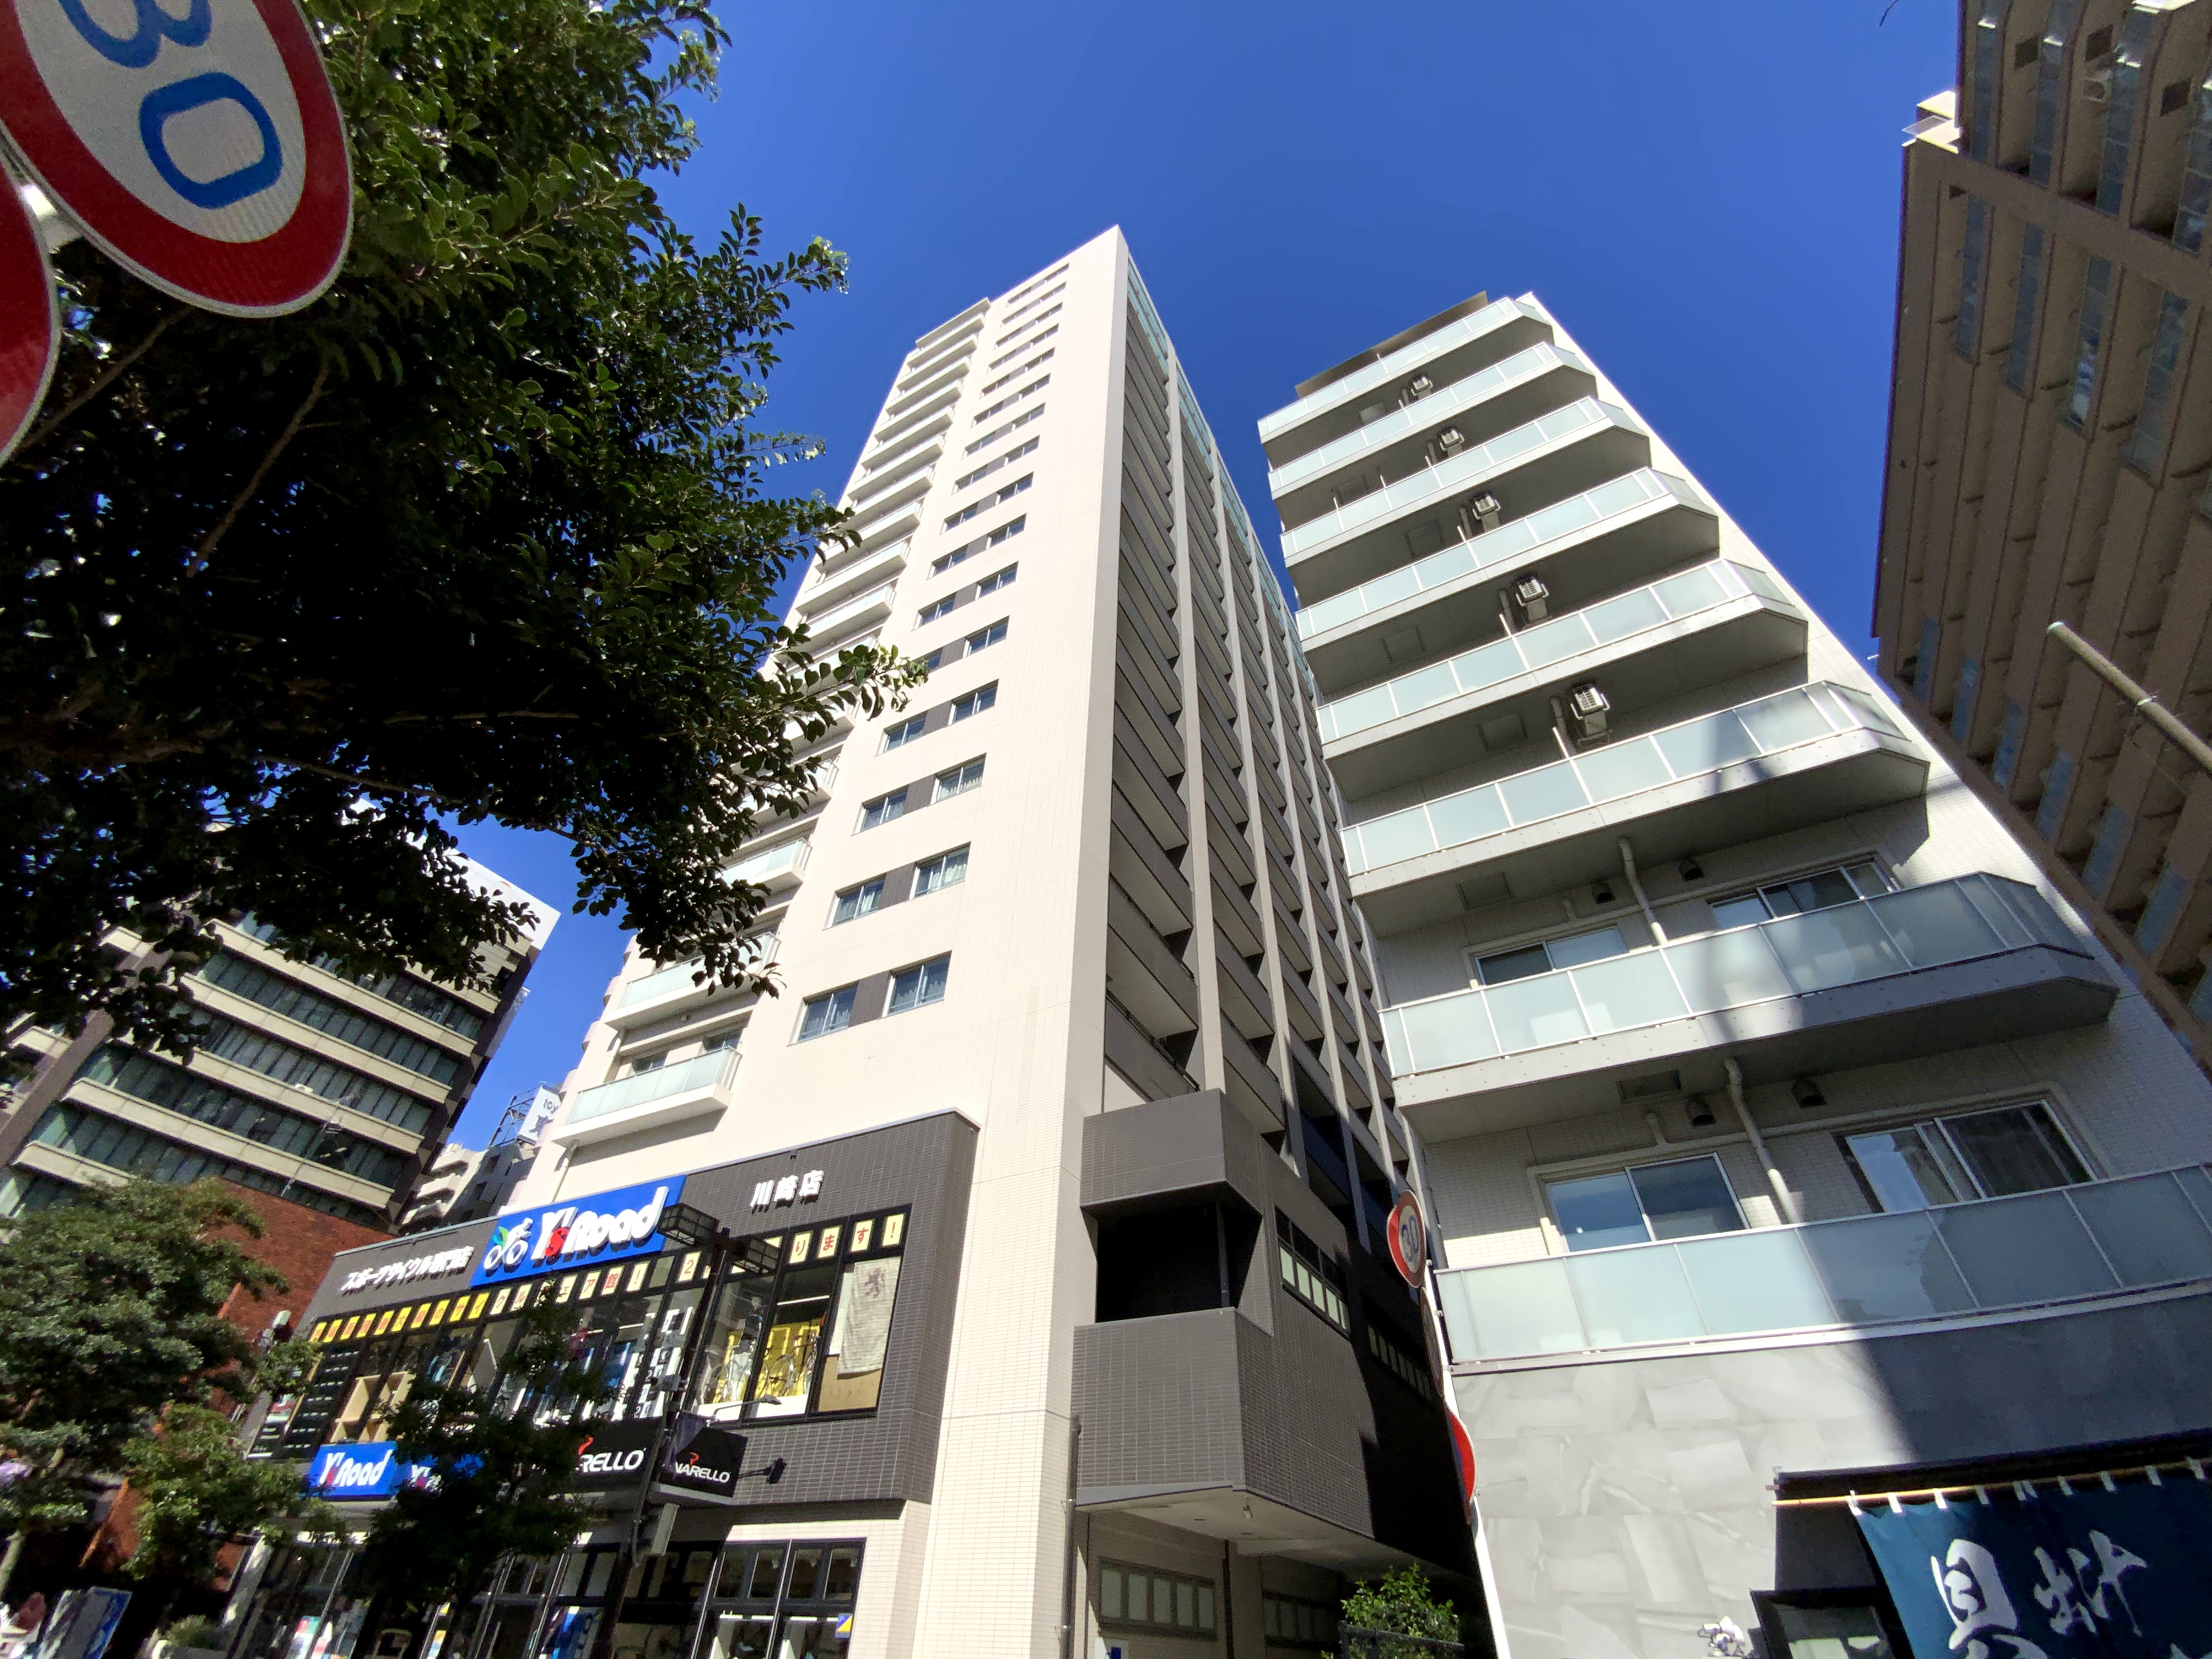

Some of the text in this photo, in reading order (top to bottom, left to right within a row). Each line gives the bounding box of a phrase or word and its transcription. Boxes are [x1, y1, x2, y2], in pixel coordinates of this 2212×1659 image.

[750, 1170, 824, 1207] 川崎店
[1401, 1215, 1420, 1262] 30
[341, 1245, 475, 1291] スポーツサイクル専門店
[576, 1449, 645, 1473] RELLO
